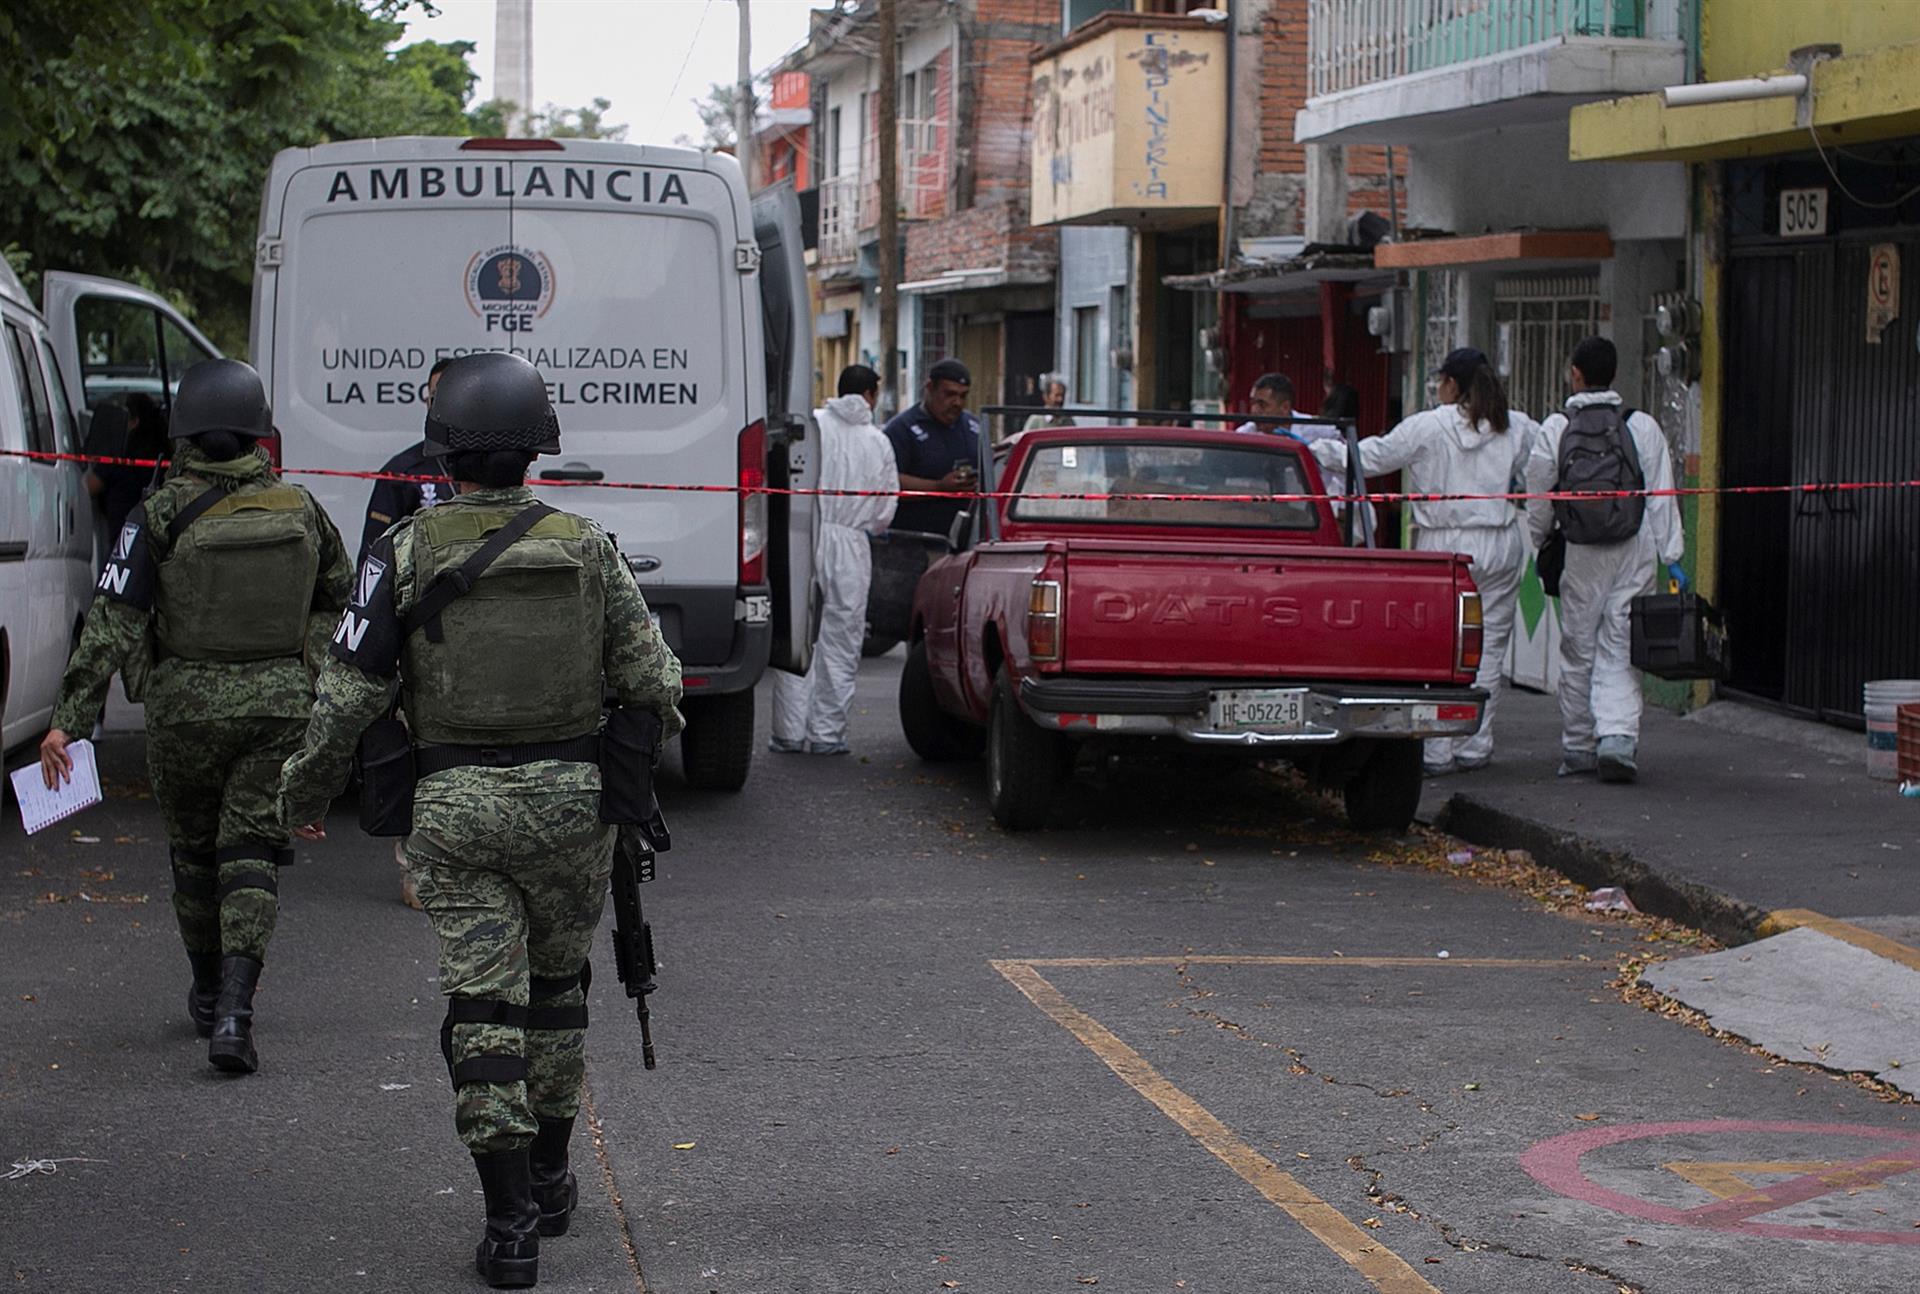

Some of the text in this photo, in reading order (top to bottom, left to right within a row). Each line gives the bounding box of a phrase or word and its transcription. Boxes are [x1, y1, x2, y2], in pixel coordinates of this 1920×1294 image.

[326, 166, 690, 205] AMBULANCIA
[1786, 193, 1818, 231] 505
[486, 313, 533, 332] FGE
[322, 347, 688, 370] UNIDAD EIALIZADA EN
[326, 382, 365, 405] LA
[546, 382, 576, 405] EL
[579, 382, 698, 405] CRIMEN
[1094, 592, 1427, 629] DATSUN
[332, 607, 370, 652] N
